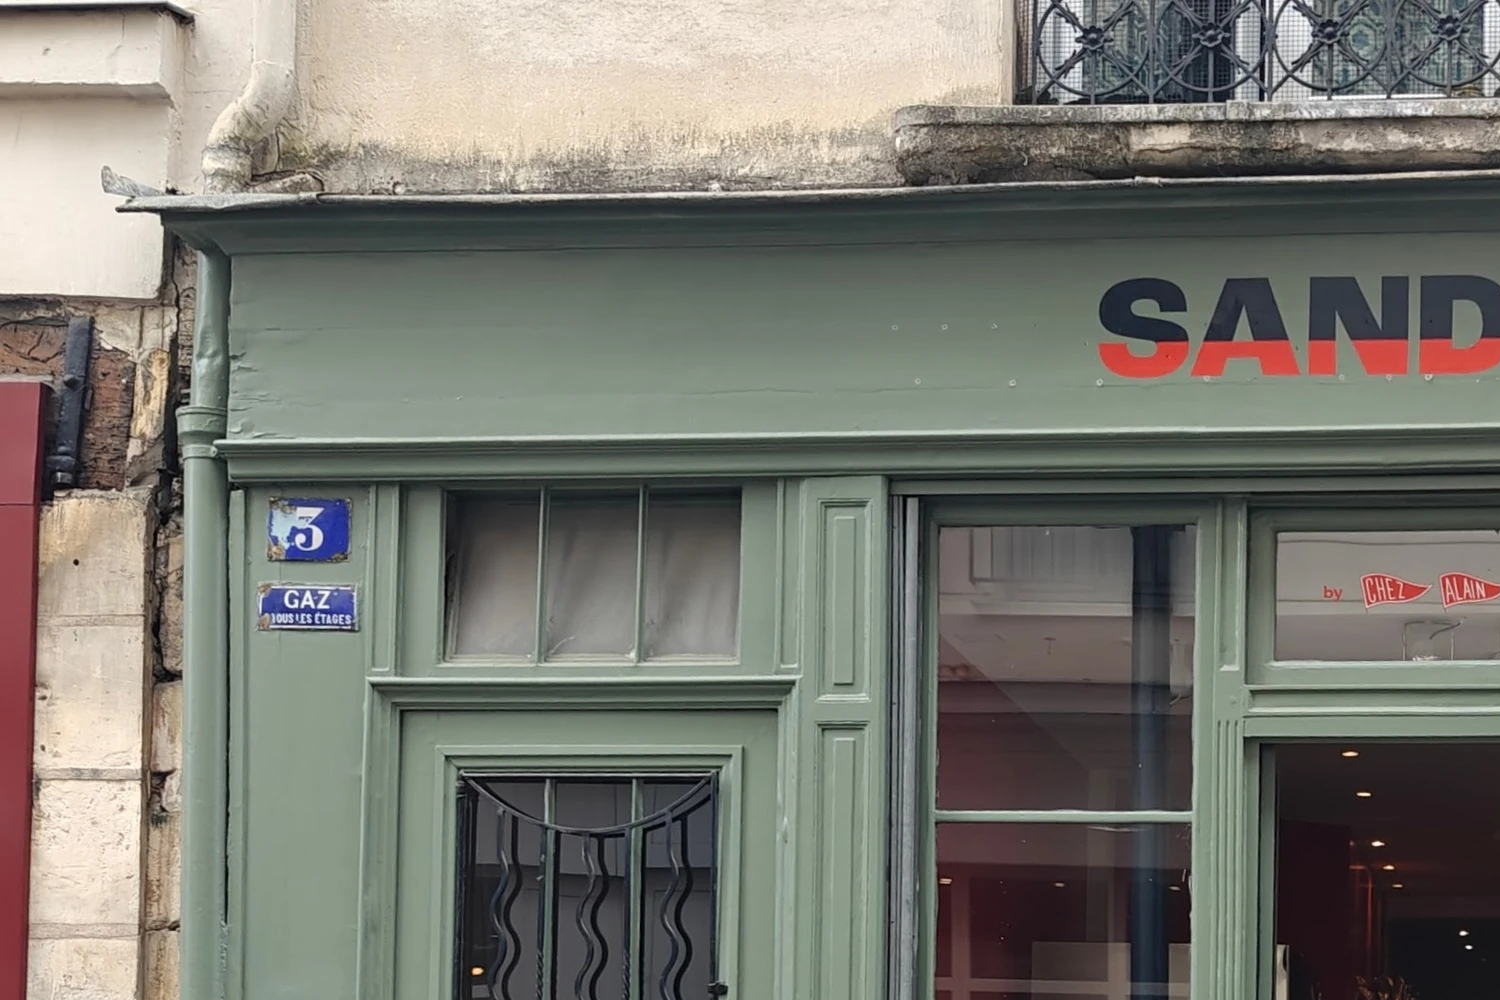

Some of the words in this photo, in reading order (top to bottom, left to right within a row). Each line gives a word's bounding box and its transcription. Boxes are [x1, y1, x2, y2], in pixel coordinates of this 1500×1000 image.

[295, 506, 325, 551] 3
[284, 590, 331, 610] GAZ
[1323, 586, 1343, 601] by
[1366, 577, 1406, 603] CHEZ
[1445, 576, 1487, 603] ALAIN
[315, 611, 352, 625] ÉTAGES
